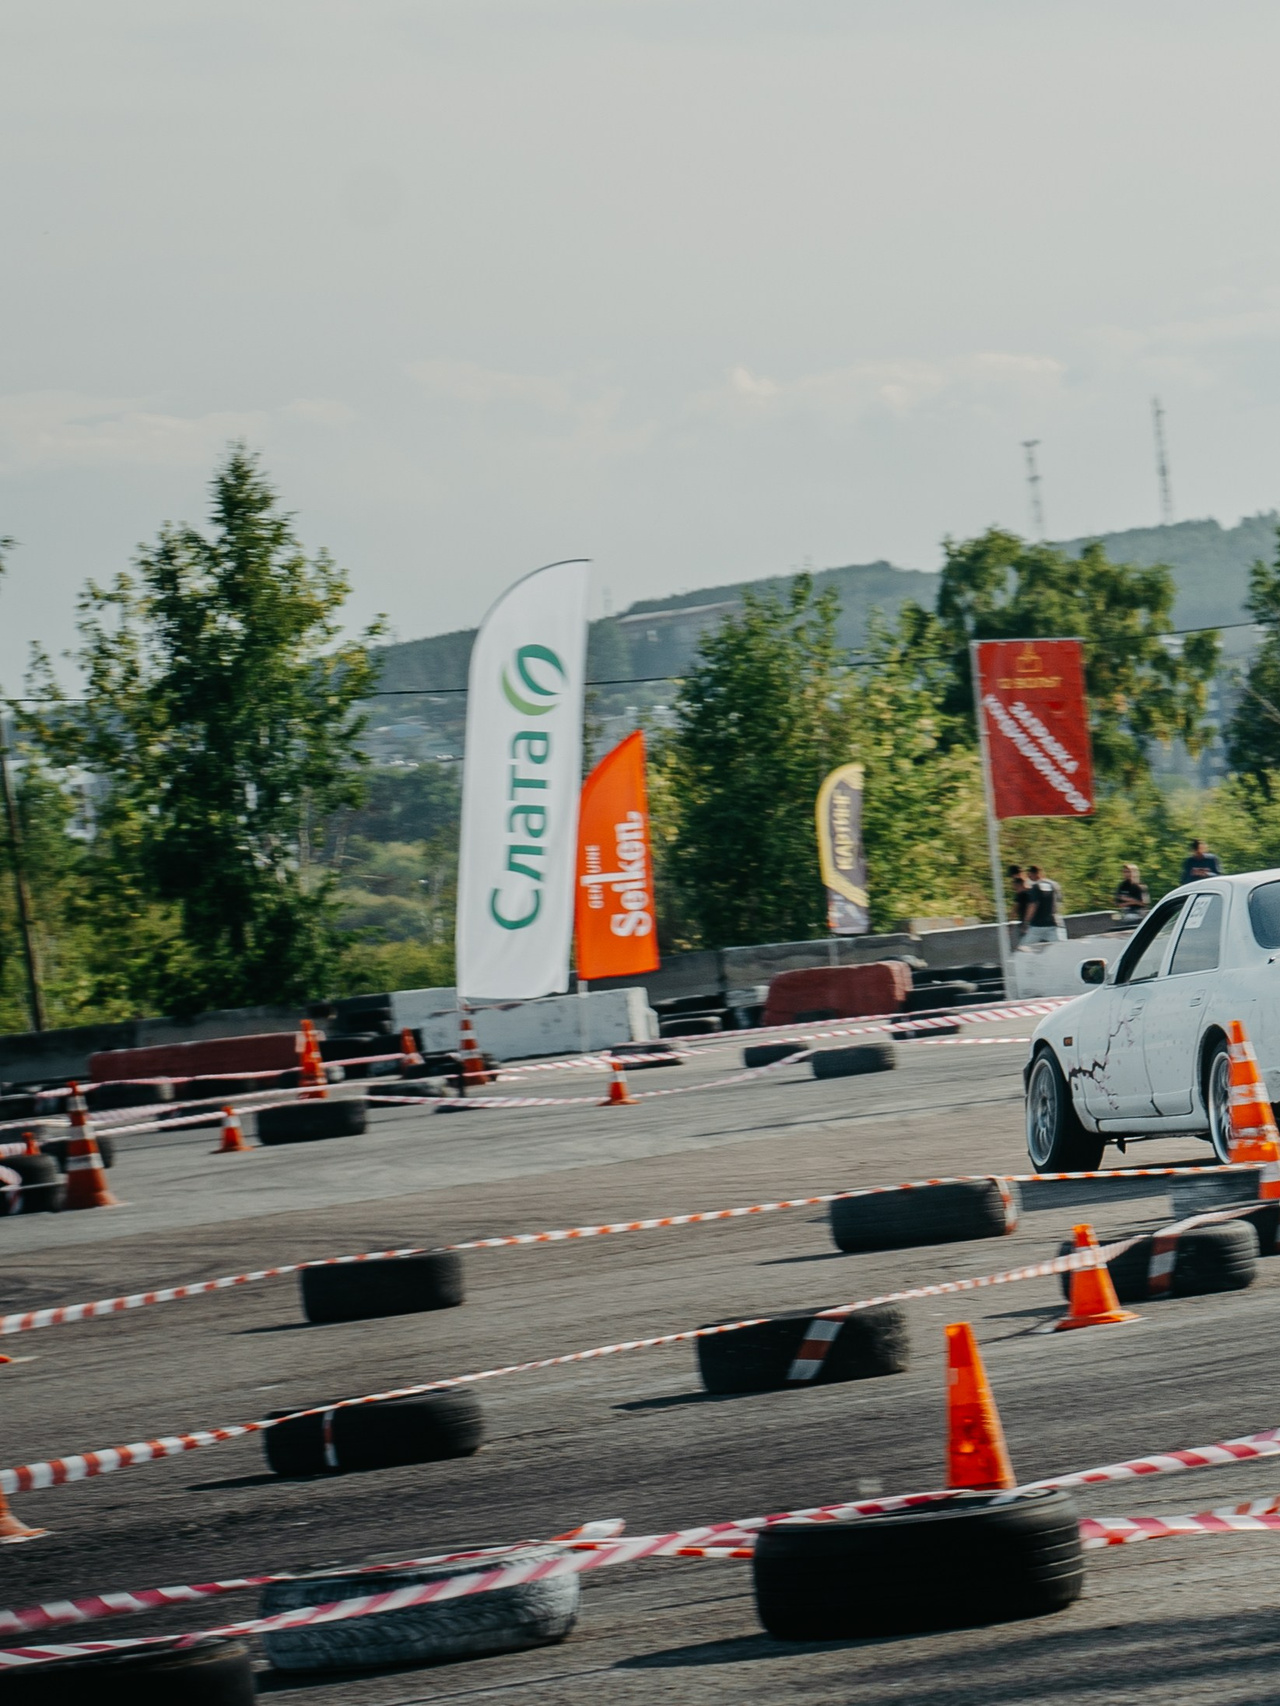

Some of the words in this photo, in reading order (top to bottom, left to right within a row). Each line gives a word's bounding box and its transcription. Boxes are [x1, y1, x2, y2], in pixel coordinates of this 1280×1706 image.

[489, 730, 551, 931] Слата
[580, 811, 653, 938] Seiken
[586, 845, 604, 909] GENUINE
[832, 794, 854, 870] КАРТИНГ
